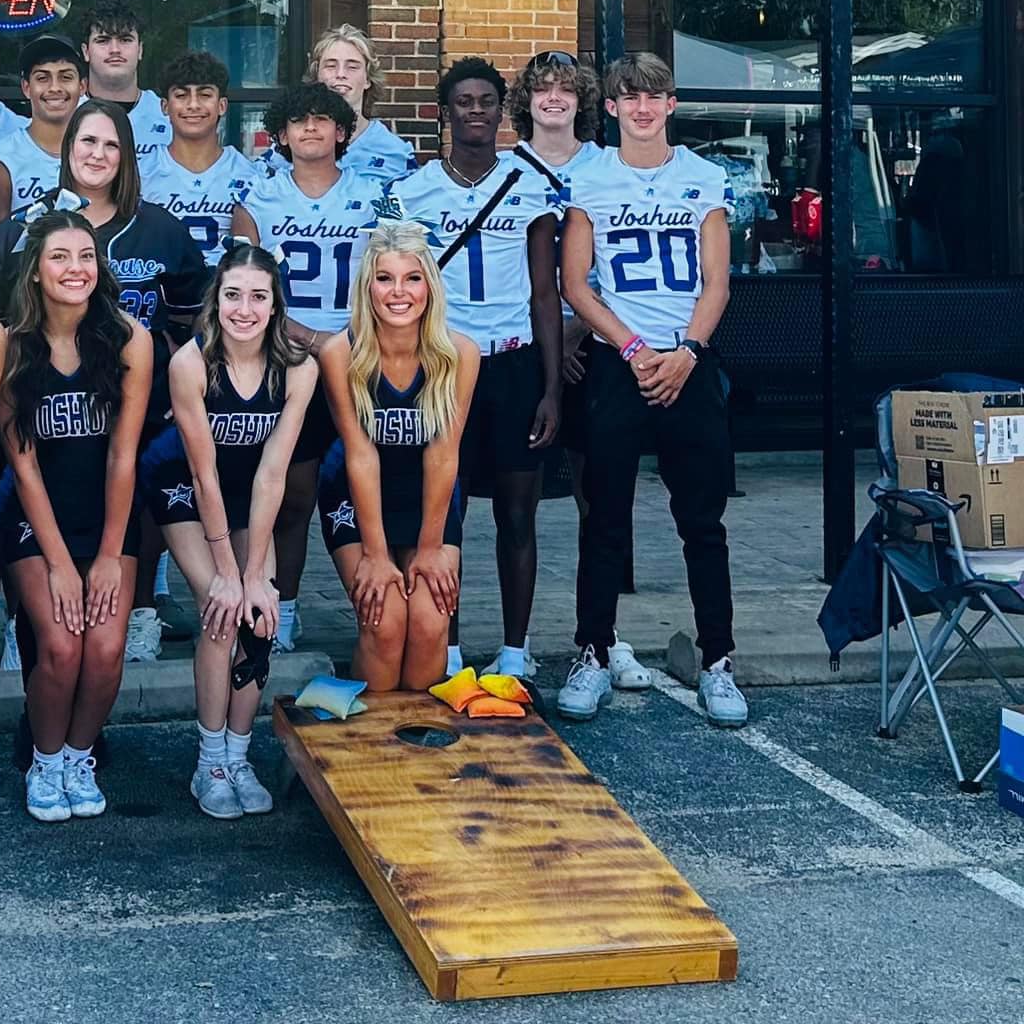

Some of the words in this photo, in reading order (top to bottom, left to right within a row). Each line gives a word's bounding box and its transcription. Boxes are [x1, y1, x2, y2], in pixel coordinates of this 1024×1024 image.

[610, 204, 692, 226] Joshua
[272, 216, 359, 238] Joshua
[607, 229, 697, 293] 20
[282, 241, 352, 309] 21
[910, 419, 925, 428] LESS
[925, 420, 959, 430] MATERIAL
[915, 410, 933, 419] MADE
[935, 410, 952, 420] WITH
